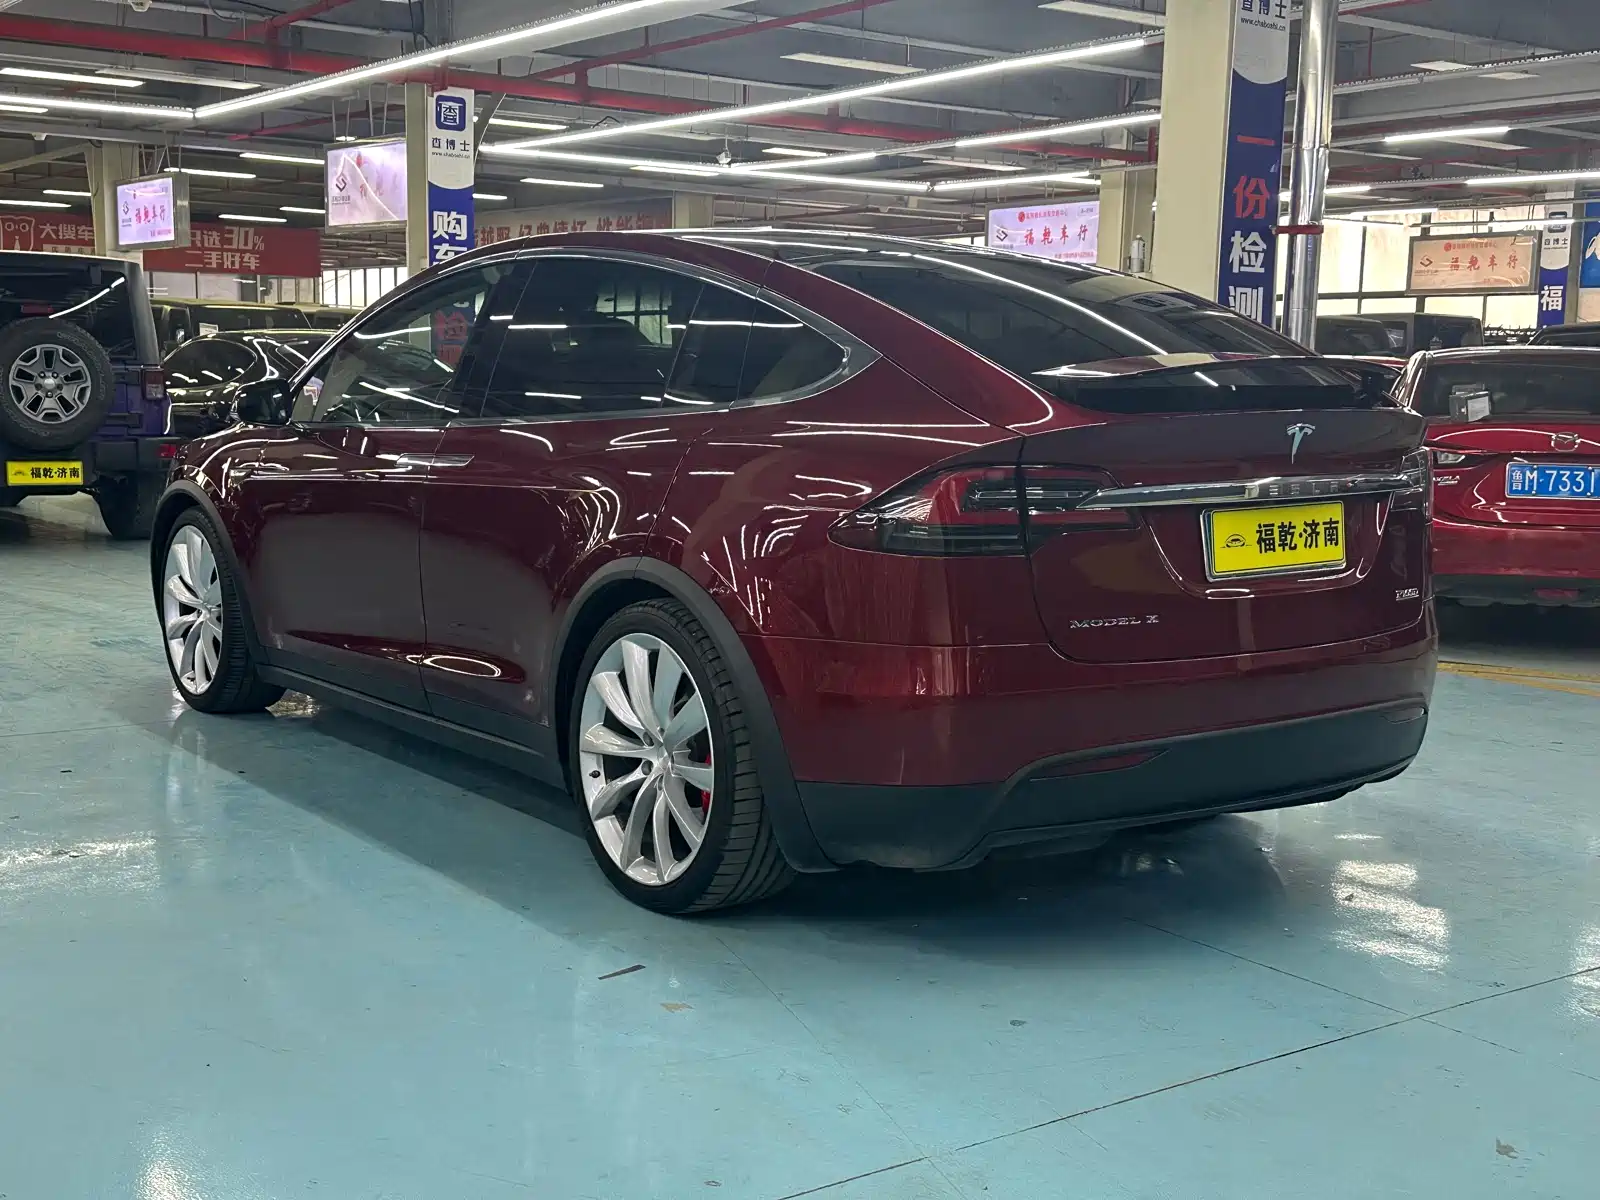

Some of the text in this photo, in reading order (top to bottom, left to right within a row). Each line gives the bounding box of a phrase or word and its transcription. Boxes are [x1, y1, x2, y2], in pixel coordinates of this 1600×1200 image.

[1241, 17, 1286, 31] www.chaboshi.cn
[432, 137, 470, 152] 查博士
[39, 223, 94, 241] 大搜车
[1229, 135, 1275, 323] 一份检测
[185, 250, 260, 270] 二手好车
[1541, 285, 1564, 311] 福
[30, 467, 80, 479] 福乾·济南
[1256, 517, 1340, 554] 福乾·济南
[1069, 615, 1159, 629] MODEL X
